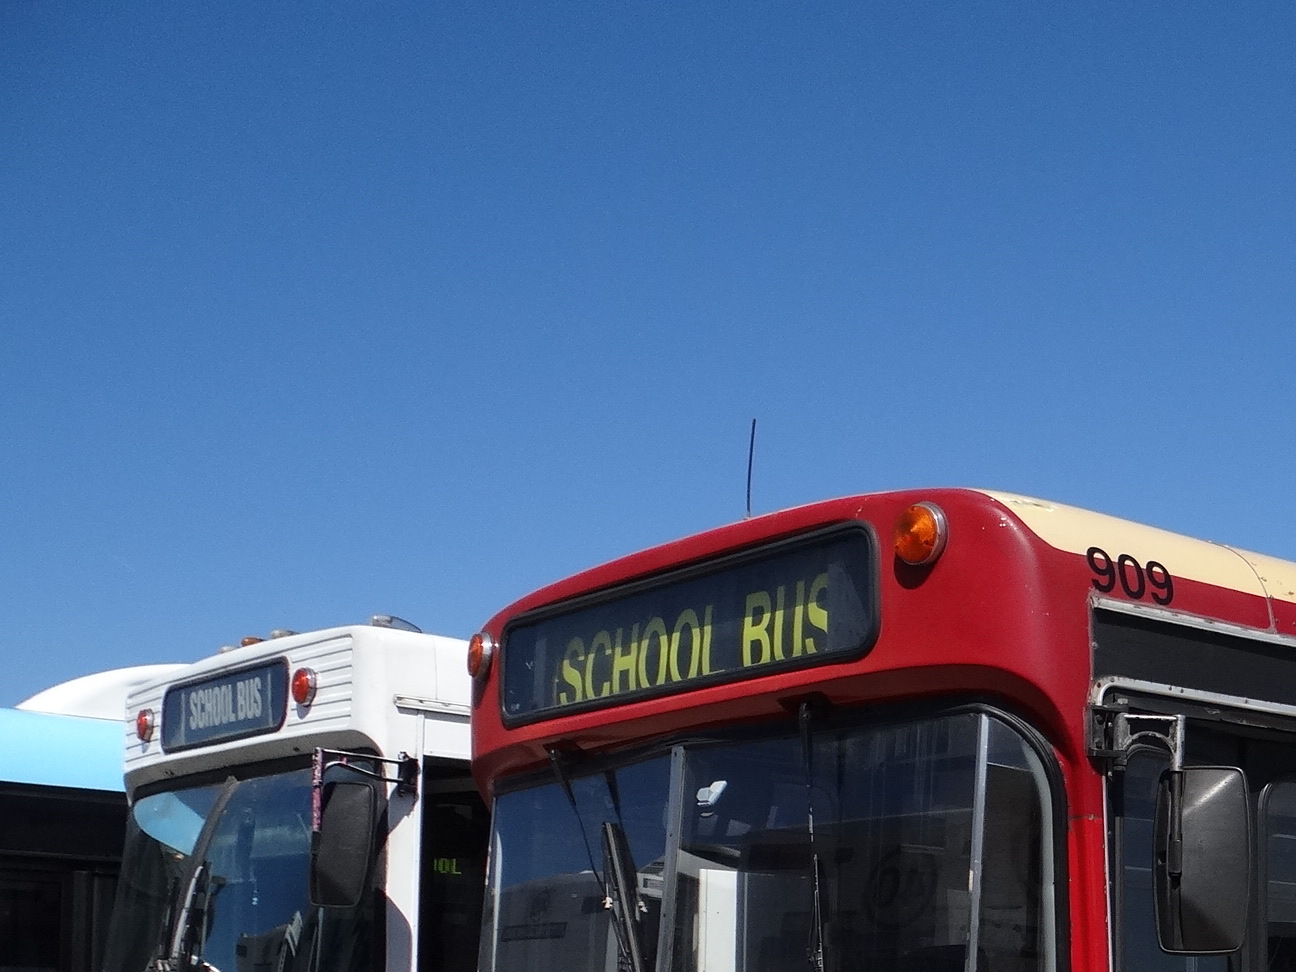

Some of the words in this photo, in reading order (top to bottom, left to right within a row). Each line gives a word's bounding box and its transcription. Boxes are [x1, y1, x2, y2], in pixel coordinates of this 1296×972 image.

[1087, 547, 1174, 606] 909
[560, 605, 725, 706] SCHOOL
[742, 572, 828, 668] BUS
[188, 684, 236, 731] SCHOOL
[237, 676, 263, 720] BUS
